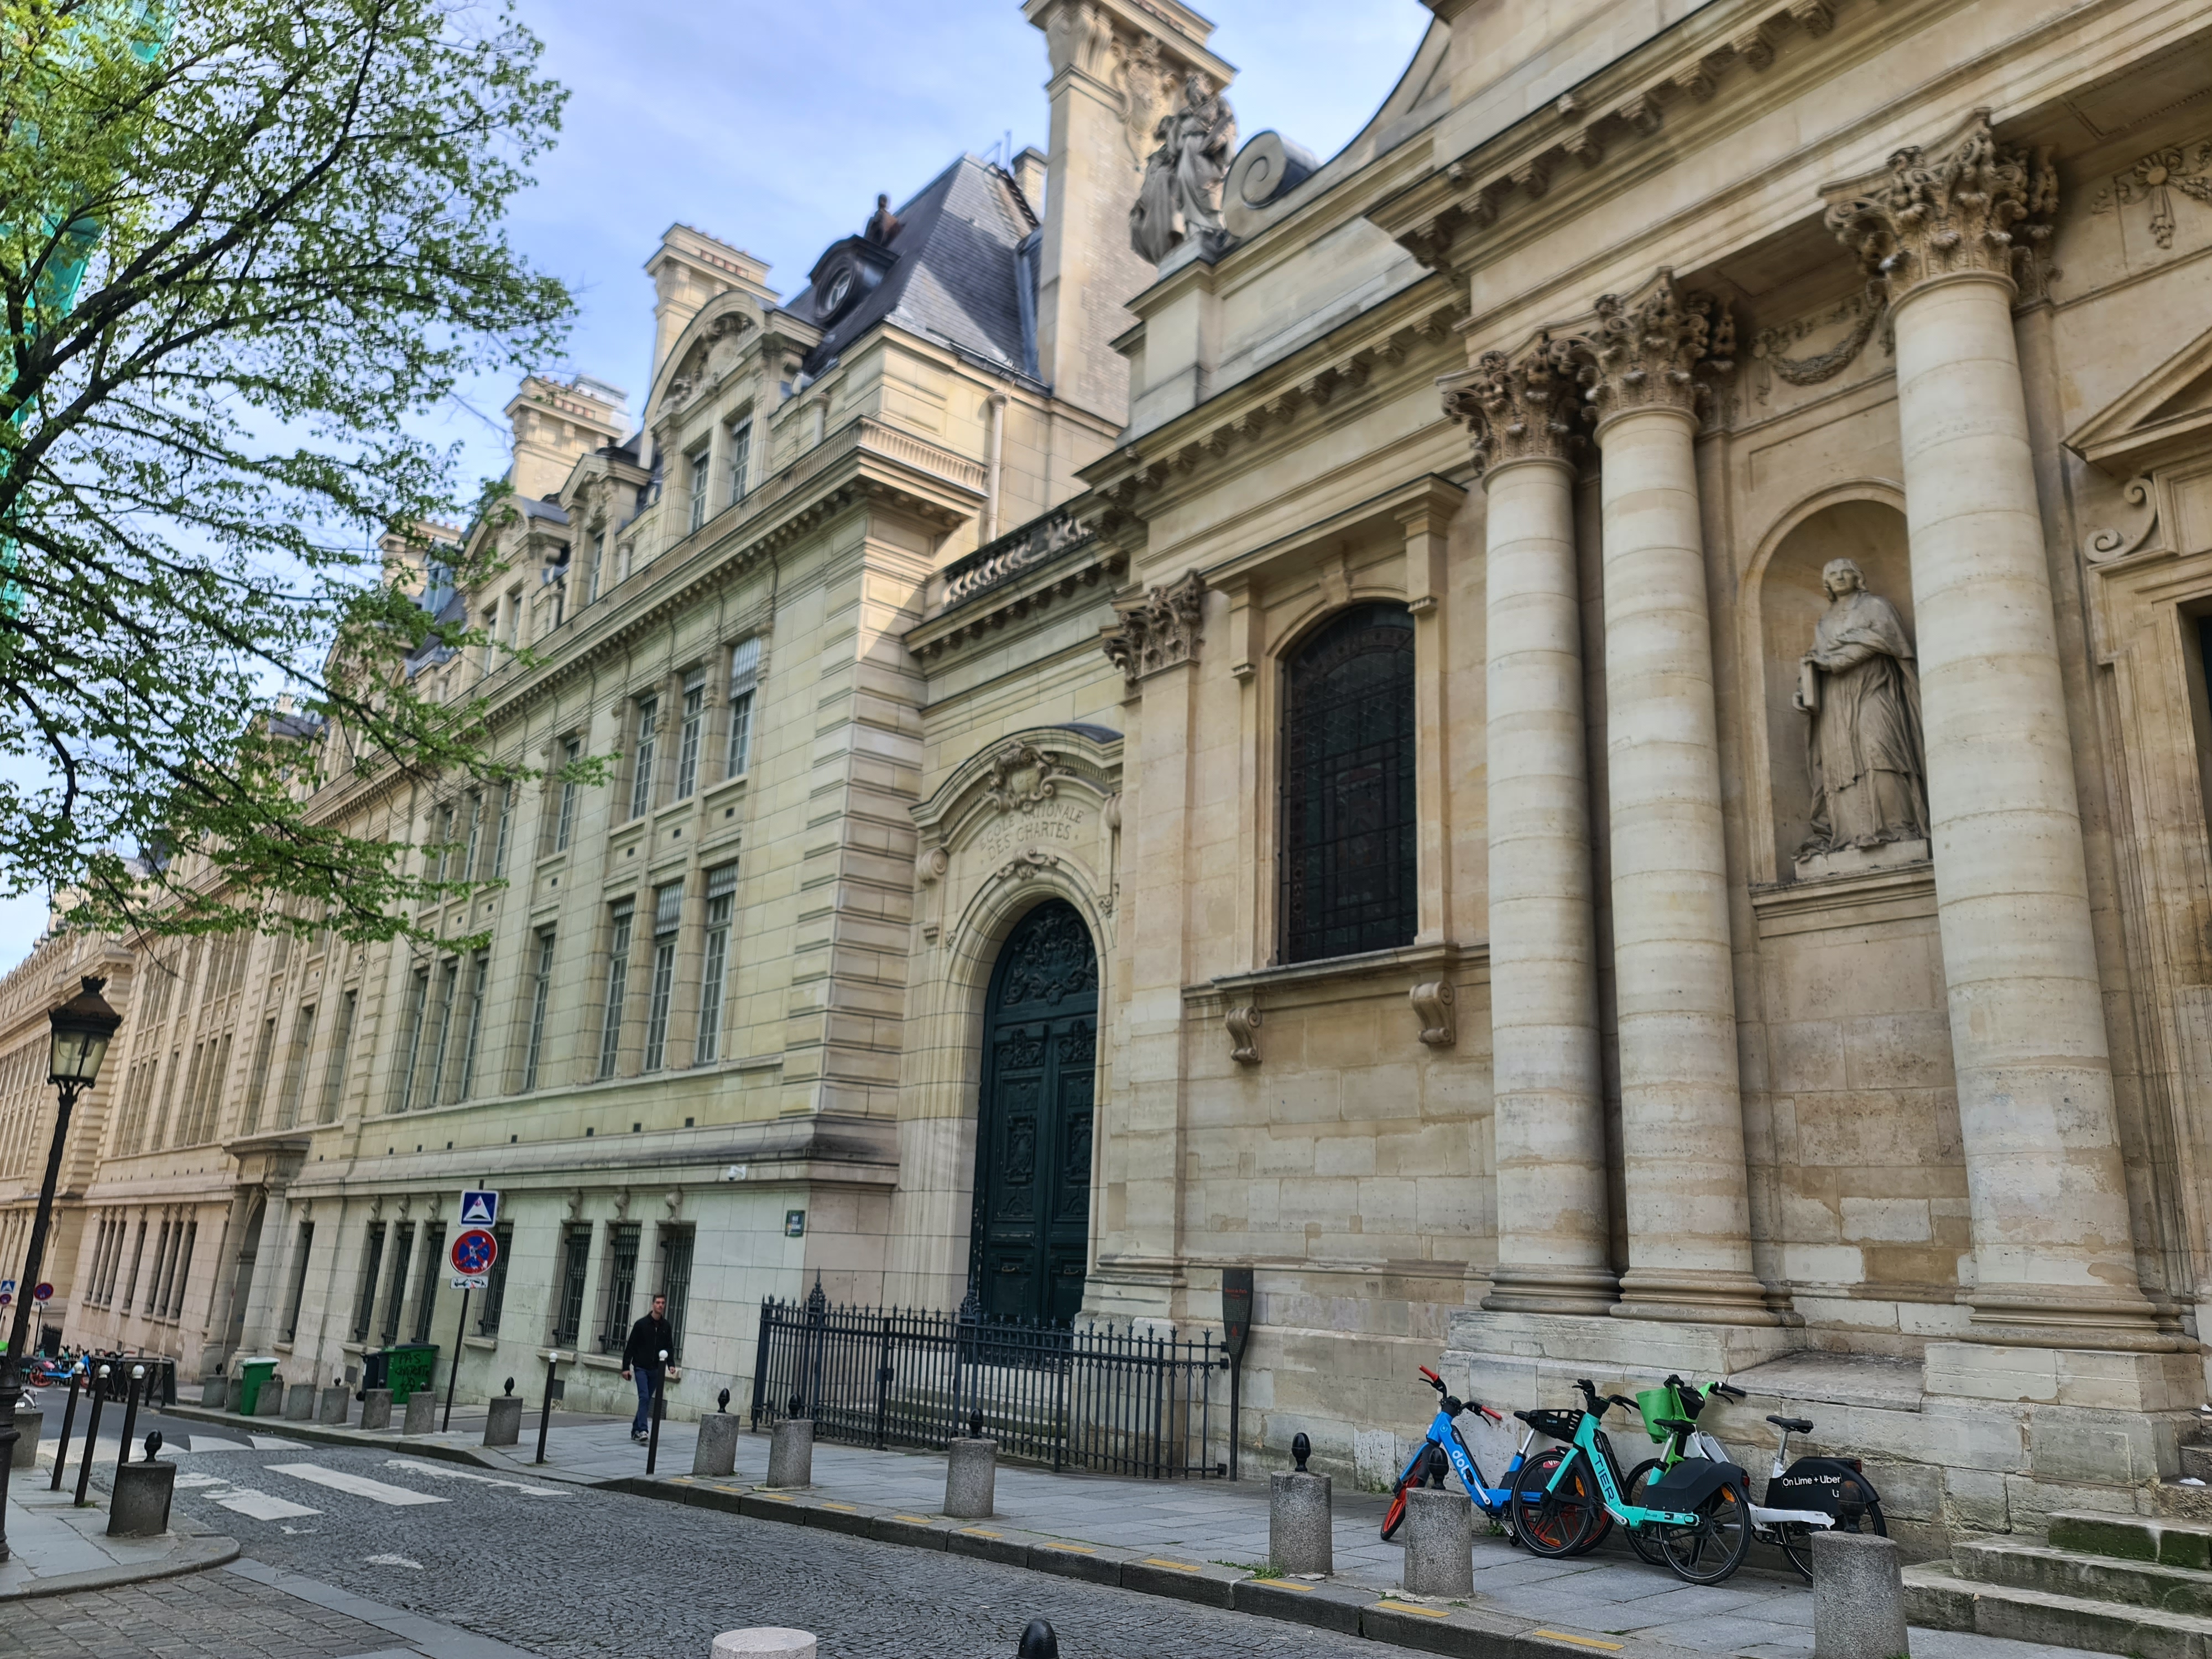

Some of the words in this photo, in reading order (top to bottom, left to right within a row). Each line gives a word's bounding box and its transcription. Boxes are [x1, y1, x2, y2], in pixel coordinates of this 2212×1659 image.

[979, 814, 1015, 851] ECOLE
[1022, 802, 1084, 824] NATIONALE
[988, 834, 1011, 862] DES
[1017, 822, 1072, 842] CHARTES
[400, 1353, 421, 1365] PAS
[1452, 1450, 1469, 1480] dot
[1595, 1454, 1614, 1503] TIER
[1782, 1478, 1793, 1486] On
[1794, 1477, 1812, 1485] Lime
[1819, 1475, 1840, 1484] Uber
